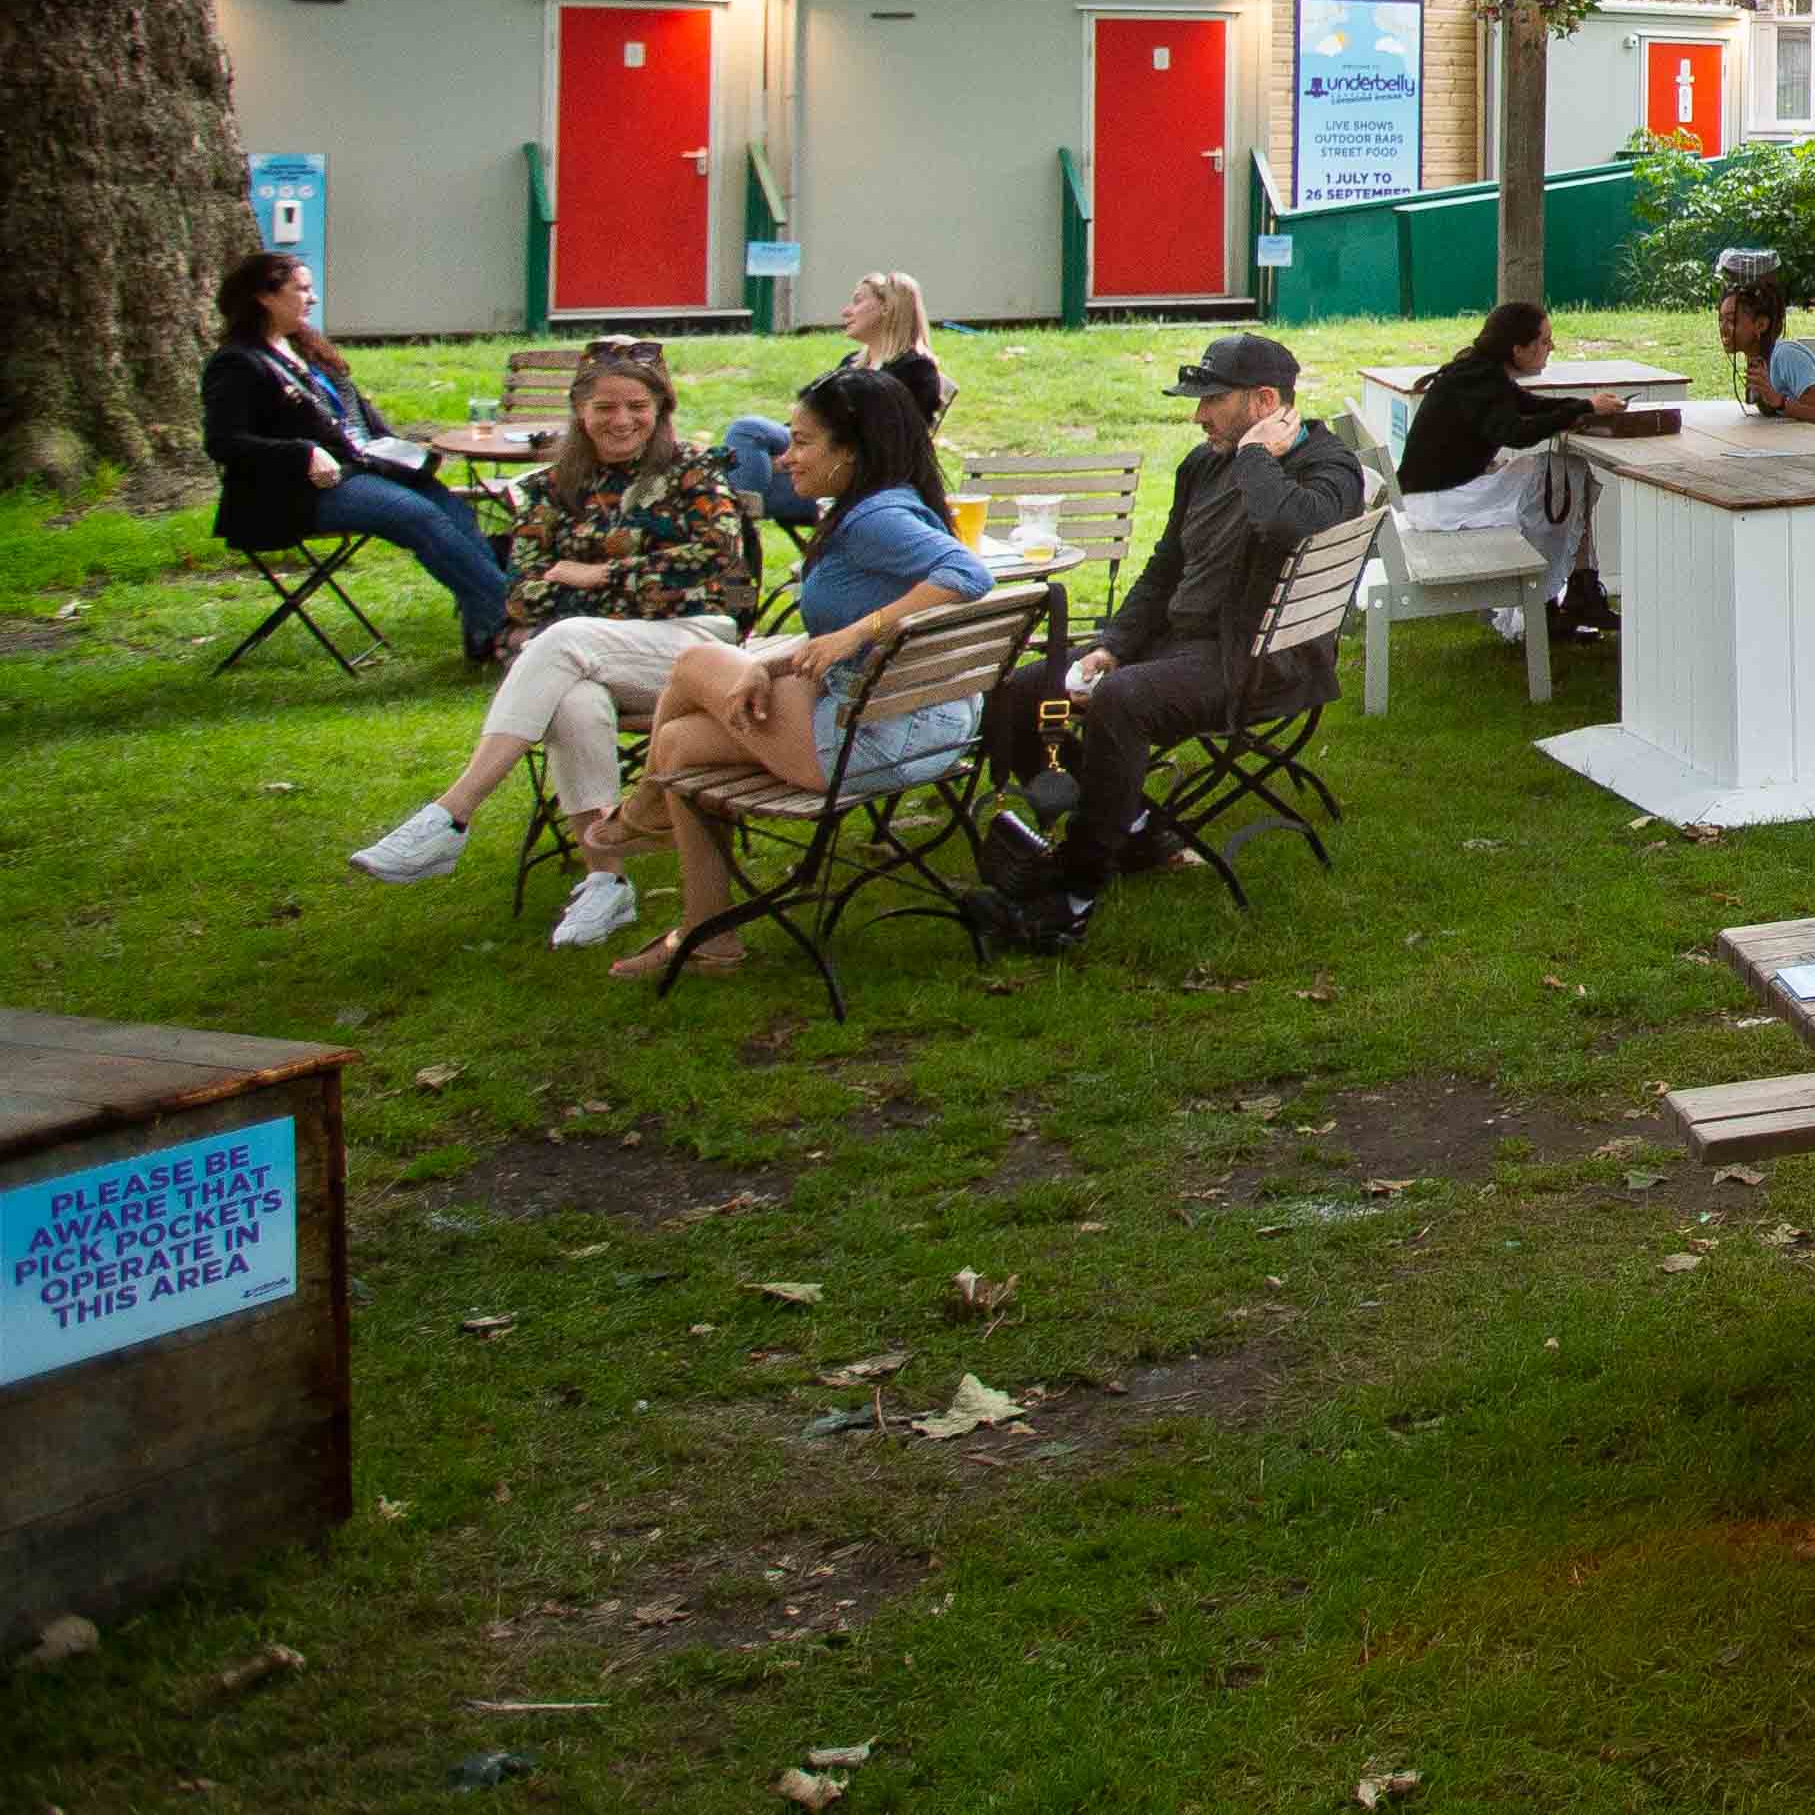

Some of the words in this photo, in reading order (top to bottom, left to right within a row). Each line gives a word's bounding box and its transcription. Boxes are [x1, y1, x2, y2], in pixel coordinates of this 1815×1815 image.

[1327, 73, 1416, 97] underbelly
[1325, 121, 1350, 131] LIVE
[1353, 121, 1394, 131] SHOWS
[1314, 134, 1373, 144] OUTDOOR
[1375, 134, 1404, 144] BARS
[1320, 147, 1362, 158] STREET
[1366, 147, 1398, 158] FOOD
[1326, 173, 1331, 184] 1
[1335, 173, 1369, 184] JULY
[1374, 173, 1392, 184] TO
[1305, 189, 1323, 201] 26
[52, 1159, 194, 1218] PLEASE
[205, 1144, 249, 1178] BE
[29, 1194, 168, 1254] AWARE
[178, 1164, 273, 1210] THAT
[15, 1239, 104, 1287] PICK
[116, 1189, 283, 1257] POCKETS
[40, 1235, 215, 1305] OPERATE
[225, 1220, 260, 1252] IN
[52, 1285, 138, 1329] THIS
[149, 1252, 250, 1302] AREA
